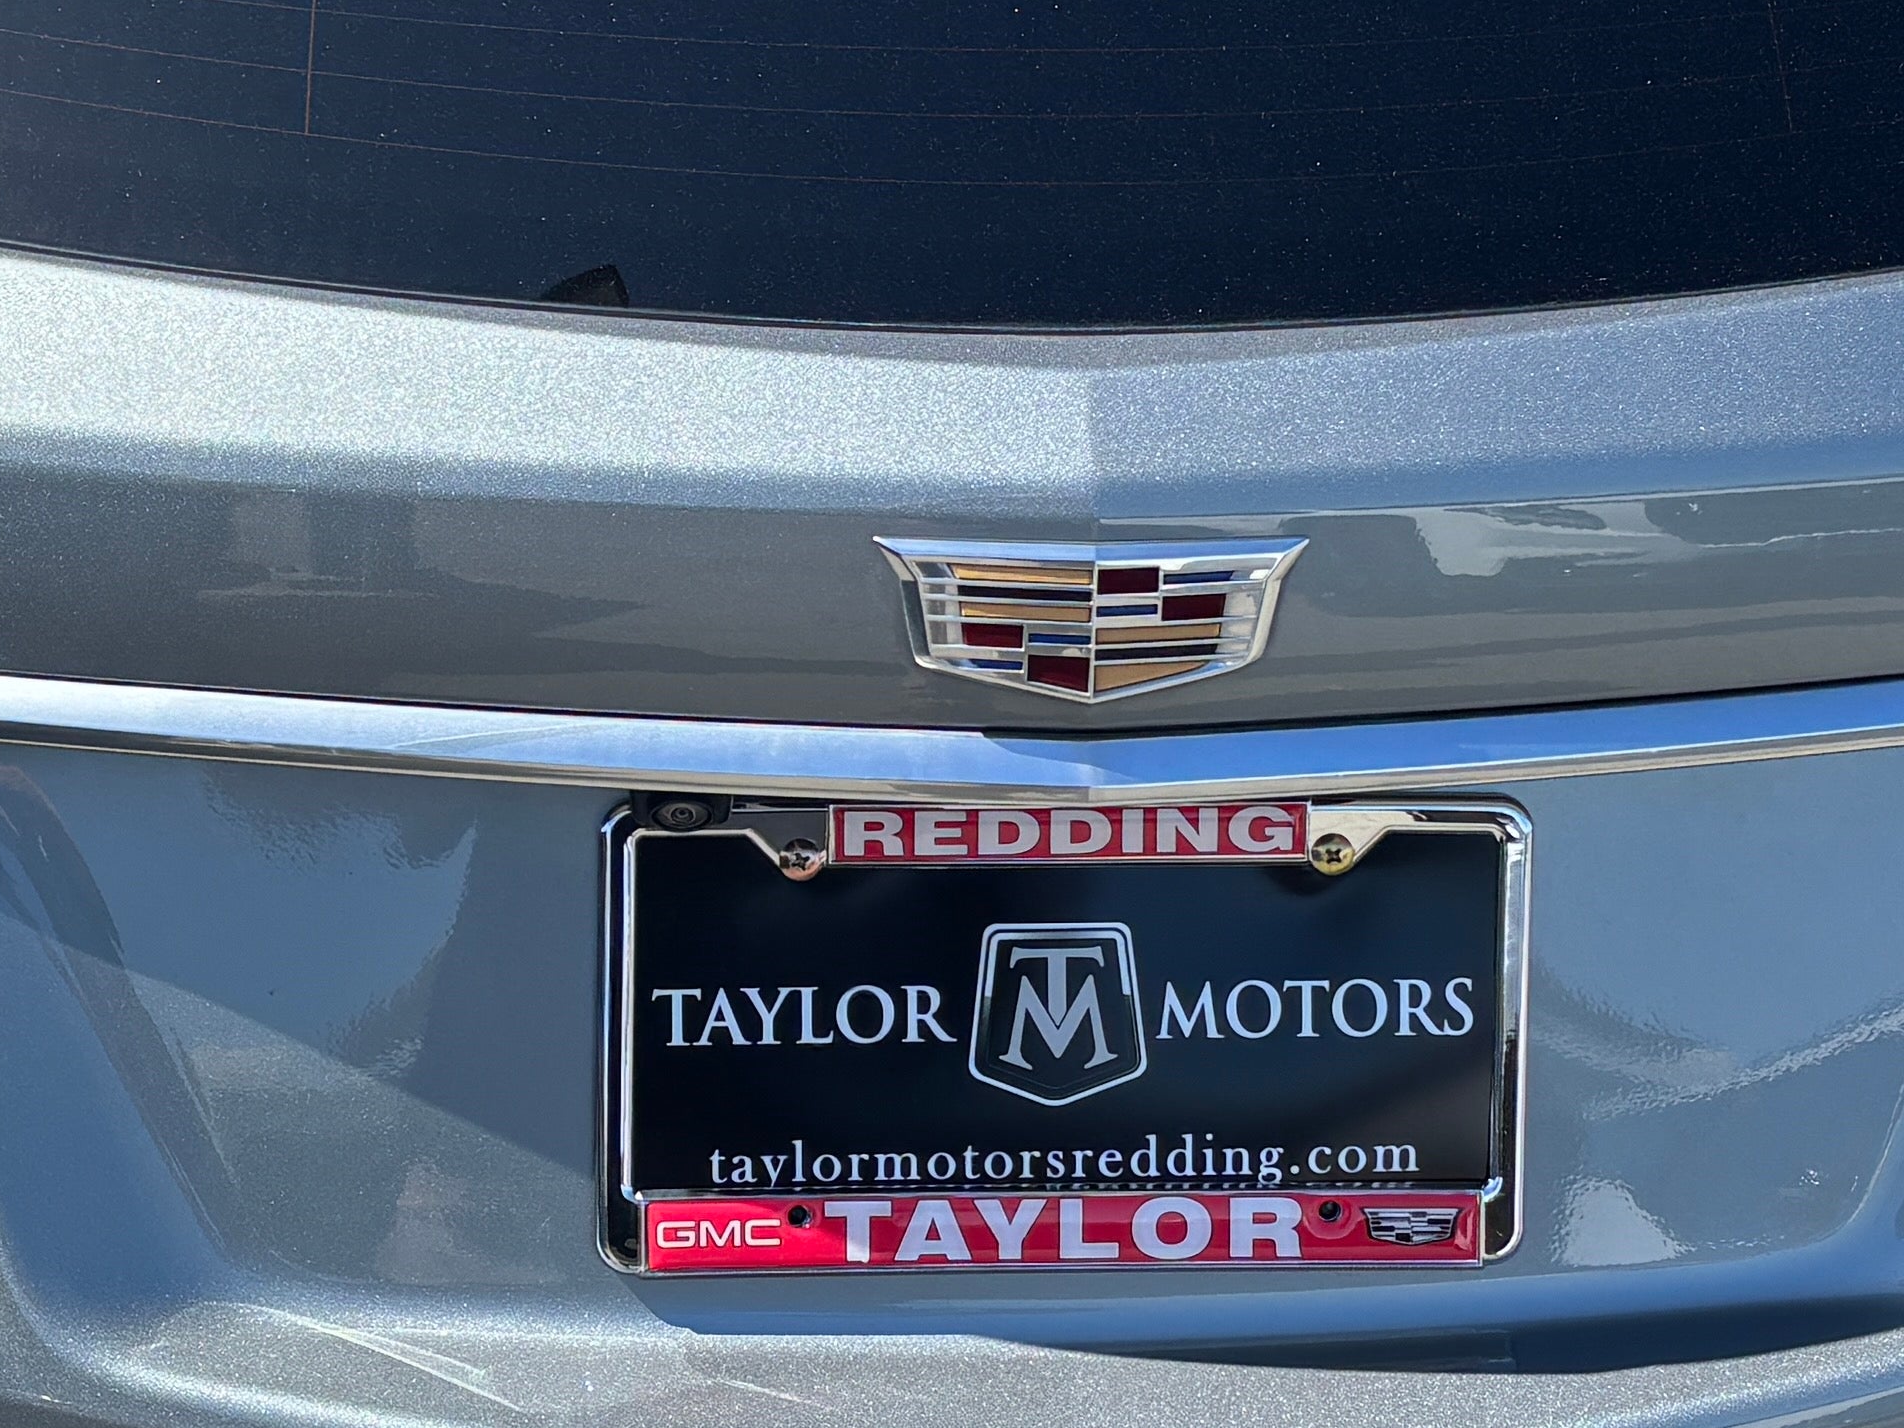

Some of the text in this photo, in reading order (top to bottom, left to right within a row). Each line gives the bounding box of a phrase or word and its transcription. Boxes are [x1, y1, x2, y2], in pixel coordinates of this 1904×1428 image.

[843, 806, 1295, 857] REDDING
[651, 984, 957, 1046] TAYLOR
[1157, 976, 1475, 1040] MOTORS
[711, 1134, 1419, 1189] taylormotorsredding.com
[656, 1196, 1304, 1262] GMC TAYLOR
